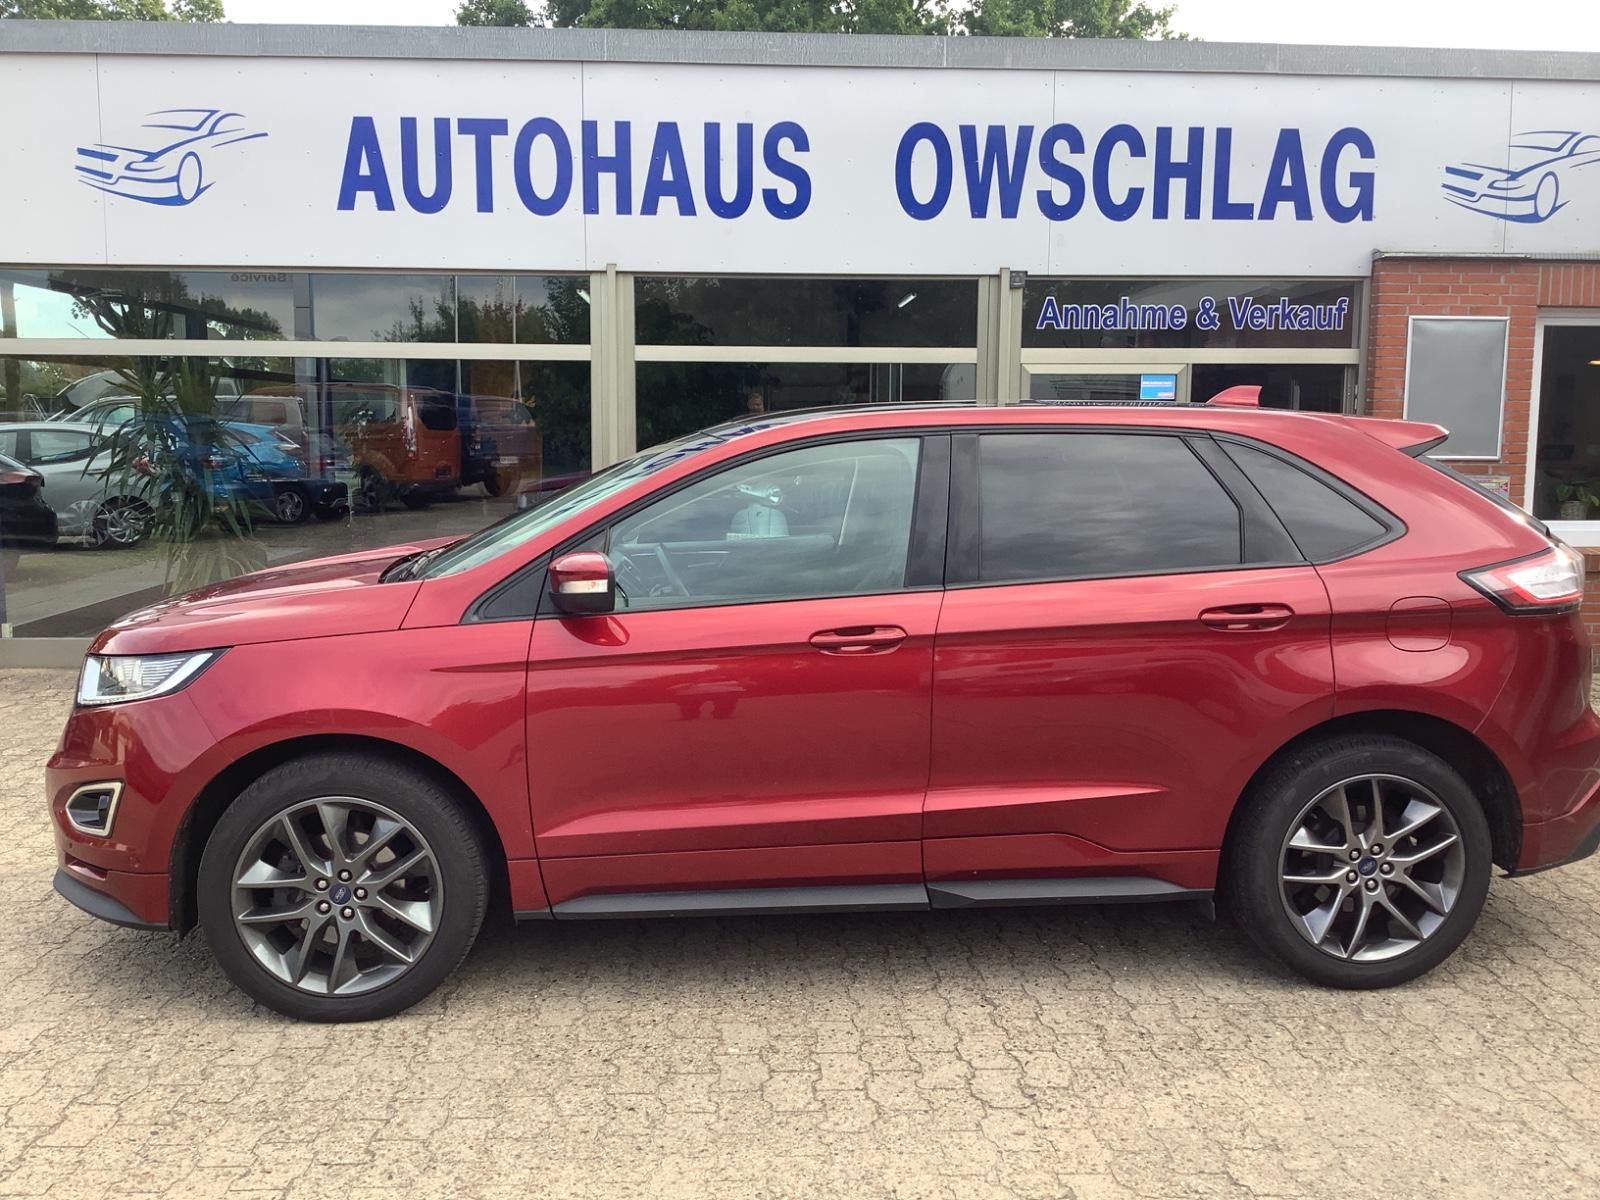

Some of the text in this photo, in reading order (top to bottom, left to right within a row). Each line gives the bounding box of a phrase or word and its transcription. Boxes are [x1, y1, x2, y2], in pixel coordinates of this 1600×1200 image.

[337, 116, 1374, 223] AUTOHAUS OWSCHLAG
[1036, 296, 1348, 331] Annahme & Verkauf
